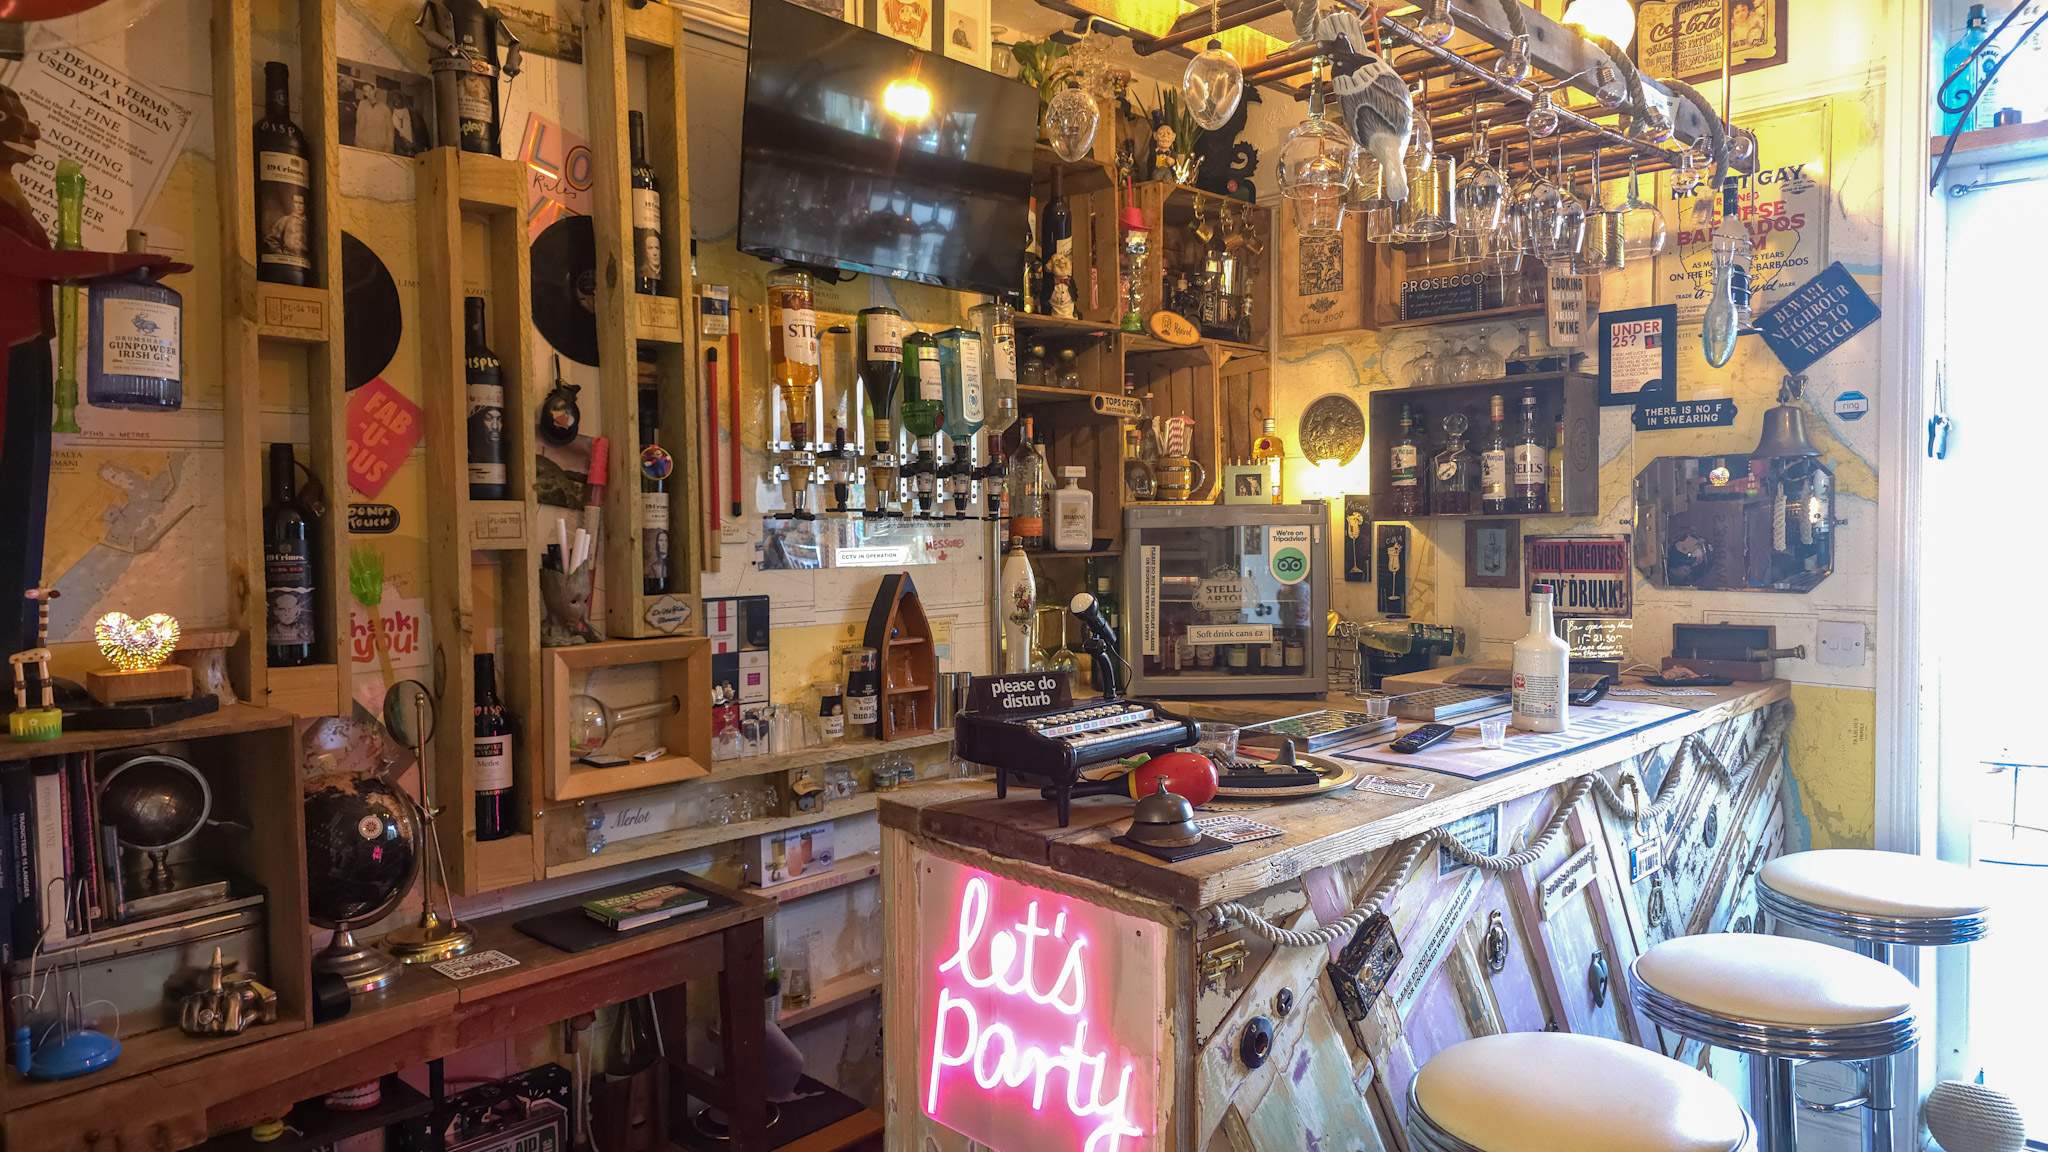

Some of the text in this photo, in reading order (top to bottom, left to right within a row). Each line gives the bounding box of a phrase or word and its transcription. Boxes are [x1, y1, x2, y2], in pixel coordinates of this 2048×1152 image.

[38, 52, 172, 132] USED BY A WOMAN
[64, 51, 169, 116] DEADLY TERMS
[85, 107, 121, 133] FINE
[48, 128, 123, 173] NOTHING
[32, 154, 56, 171] GO
[1757, 163, 1805, 185] GAY
[1756, 257, 1809, 271] BARBADOS
[1760, 251, 1785, 260] YEARS
[1401, 272, 1484, 292] PROSECCO
[1551, 277, 1583, 291] LOOKING
[1669, 271, 1703, 281] ON THE
[1773, 280, 1829, 323] BEWARE
[1558, 321, 1579, 334] WINE
[1612, 321, 1660, 336] UNDER
[1790, 303, 1849, 349] LIKES TO
[1805, 319, 1854, 355] WATCH
[109, 341, 176, 356] GUNPOWDER
[1612, 335, 1637, 348] 25?
[119, 350, 150, 359] IRISH
[1105, 397, 1120, 406] TOPS
[1644, 404, 1722, 416] THERE IS NO F
[363, 391, 413, 435] FAB
[1647, 413, 1719, 426] IN SWEARING
[1532, 543, 1624, 571] AVOID HANGOVERS
[1569, 579, 1624, 609] DRUNK!
[1196, 630, 1212, 639] Soft
[1213, 629, 1234, 638] drink
[991, 675, 1057, 698] please do
[1002, 691, 1051, 709] disturb
[610, 807, 650, 829] Merlot
[938, 876, 1088, 1015] let's
[1411, 967, 1420, 979] DO
[1418, 949, 1429, 967] NOT
[1435, 924, 1445, 937] THE
[1443, 896, 1461, 925] DISPLAY
[1407, 987, 1415, 1000] OR
[1414, 946, 1439, 987] UNOPENED
[1436, 926, 1451, 950] WINES
[1449, 911, 1460, 928] AND
[927, 987, 1144, 1152] party
